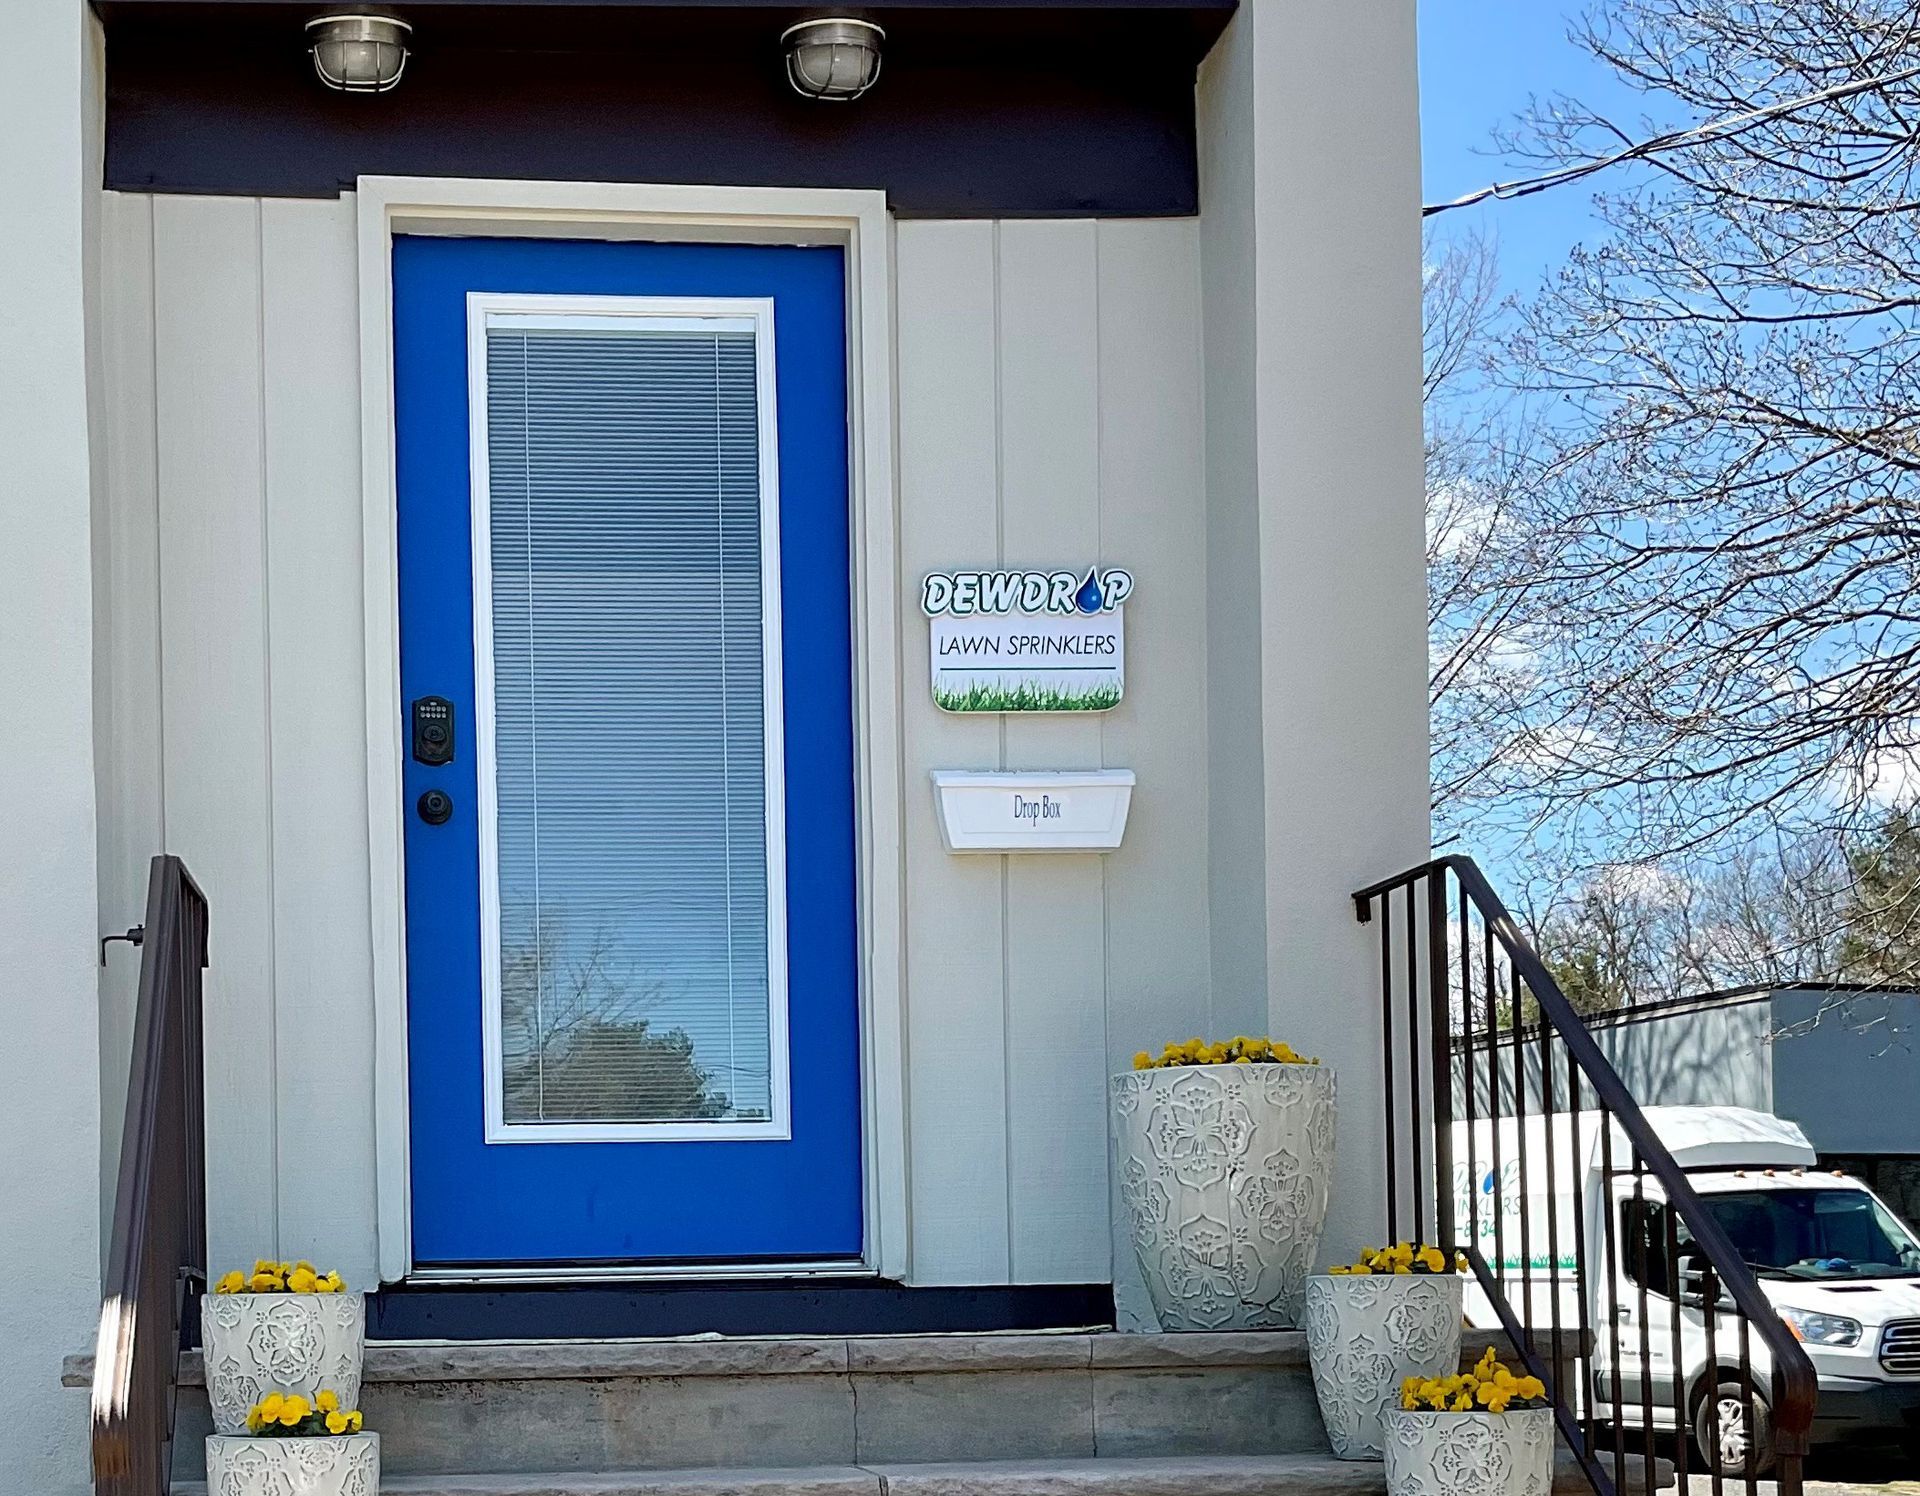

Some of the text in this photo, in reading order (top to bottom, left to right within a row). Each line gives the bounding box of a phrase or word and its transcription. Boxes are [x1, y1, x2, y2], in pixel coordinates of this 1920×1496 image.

[923, 567, 1132, 614] DEWDROP
[939, 635, 1116, 655] LAWN SPRINKLERS
[1014, 795, 1061, 826] Drop Box
